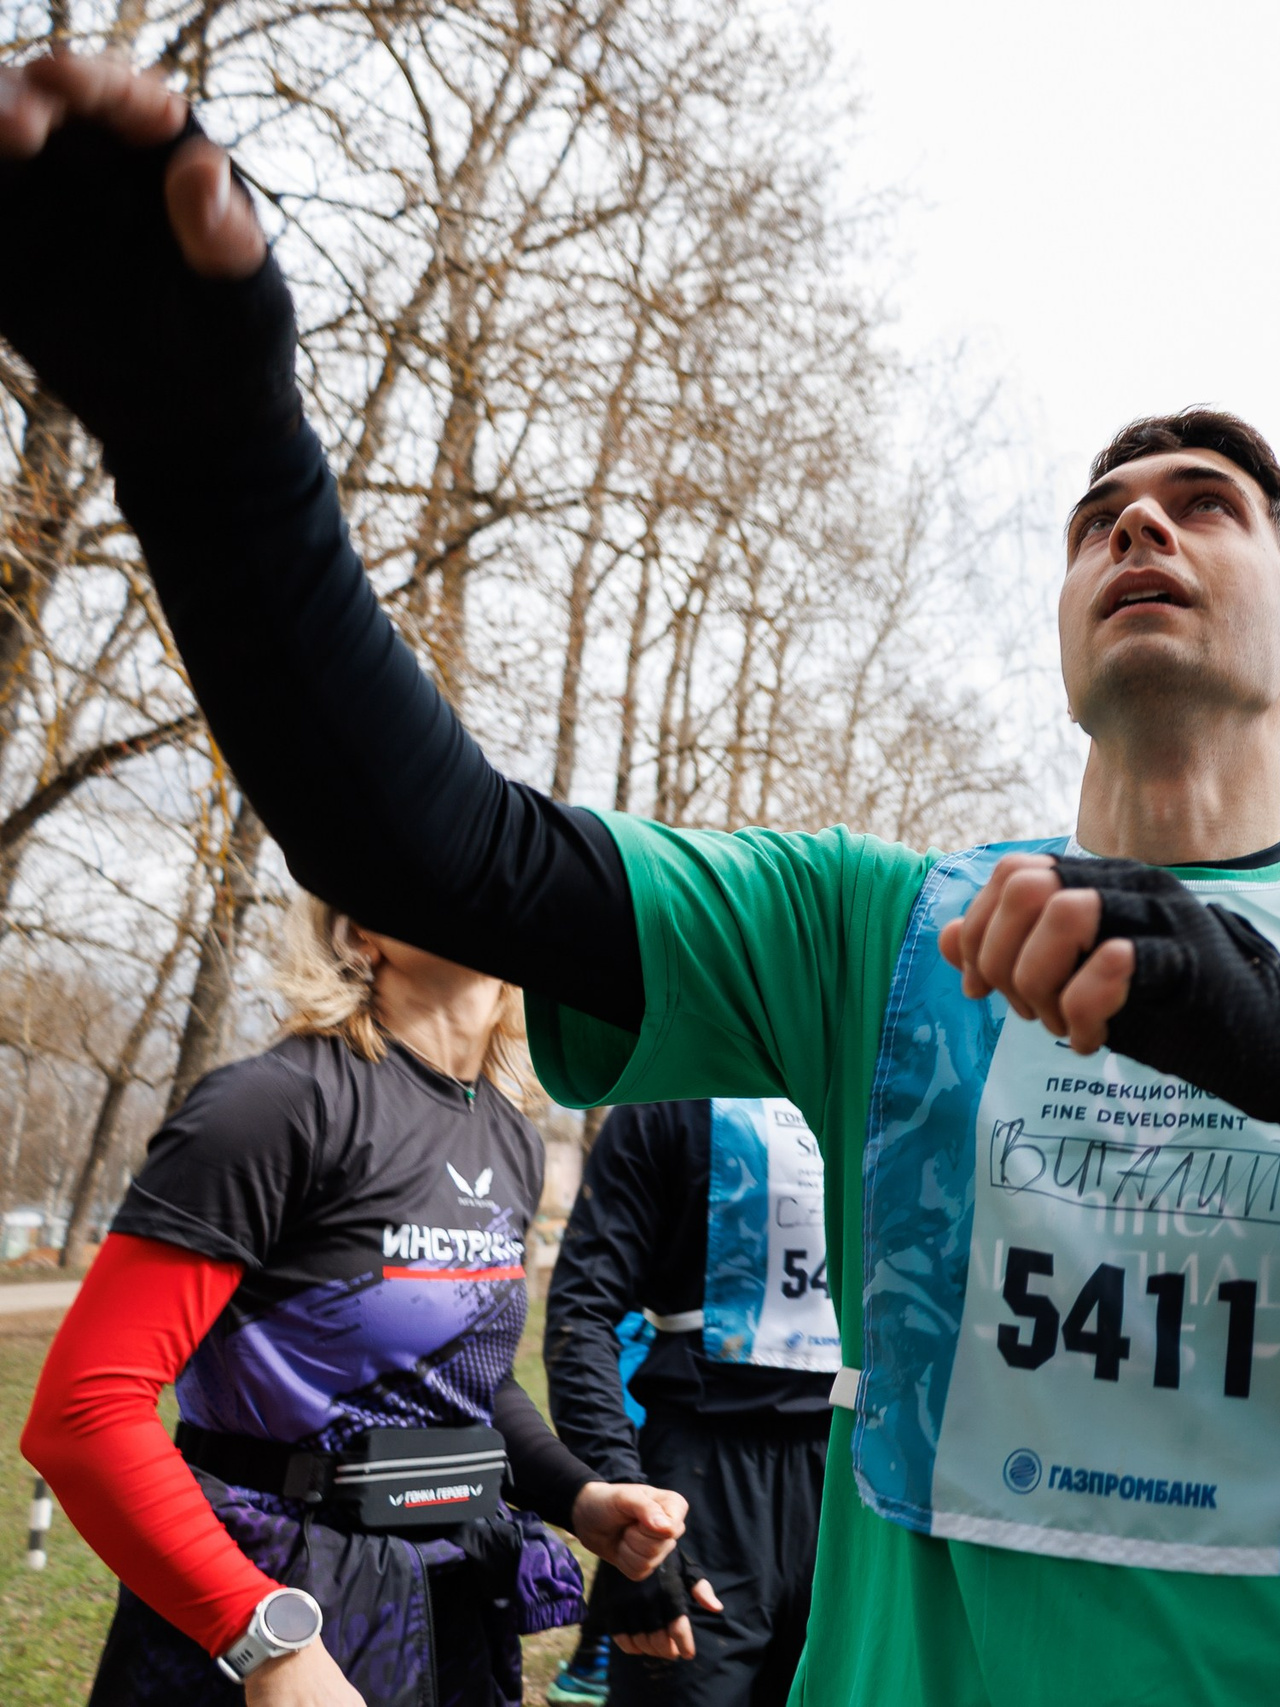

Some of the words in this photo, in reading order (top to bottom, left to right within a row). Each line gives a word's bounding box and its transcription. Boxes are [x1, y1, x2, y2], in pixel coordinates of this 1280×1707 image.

[1041, 1104, 1087, 1121] FINE
[1097, 1109, 1248, 1131] DEVELOPMENT
[781, 1250, 831, 1299] 54
[997, 1247, 1257, 1398] 5411
[1048, 1465, 1217, 1509] ГАЗПРОМБАНК
